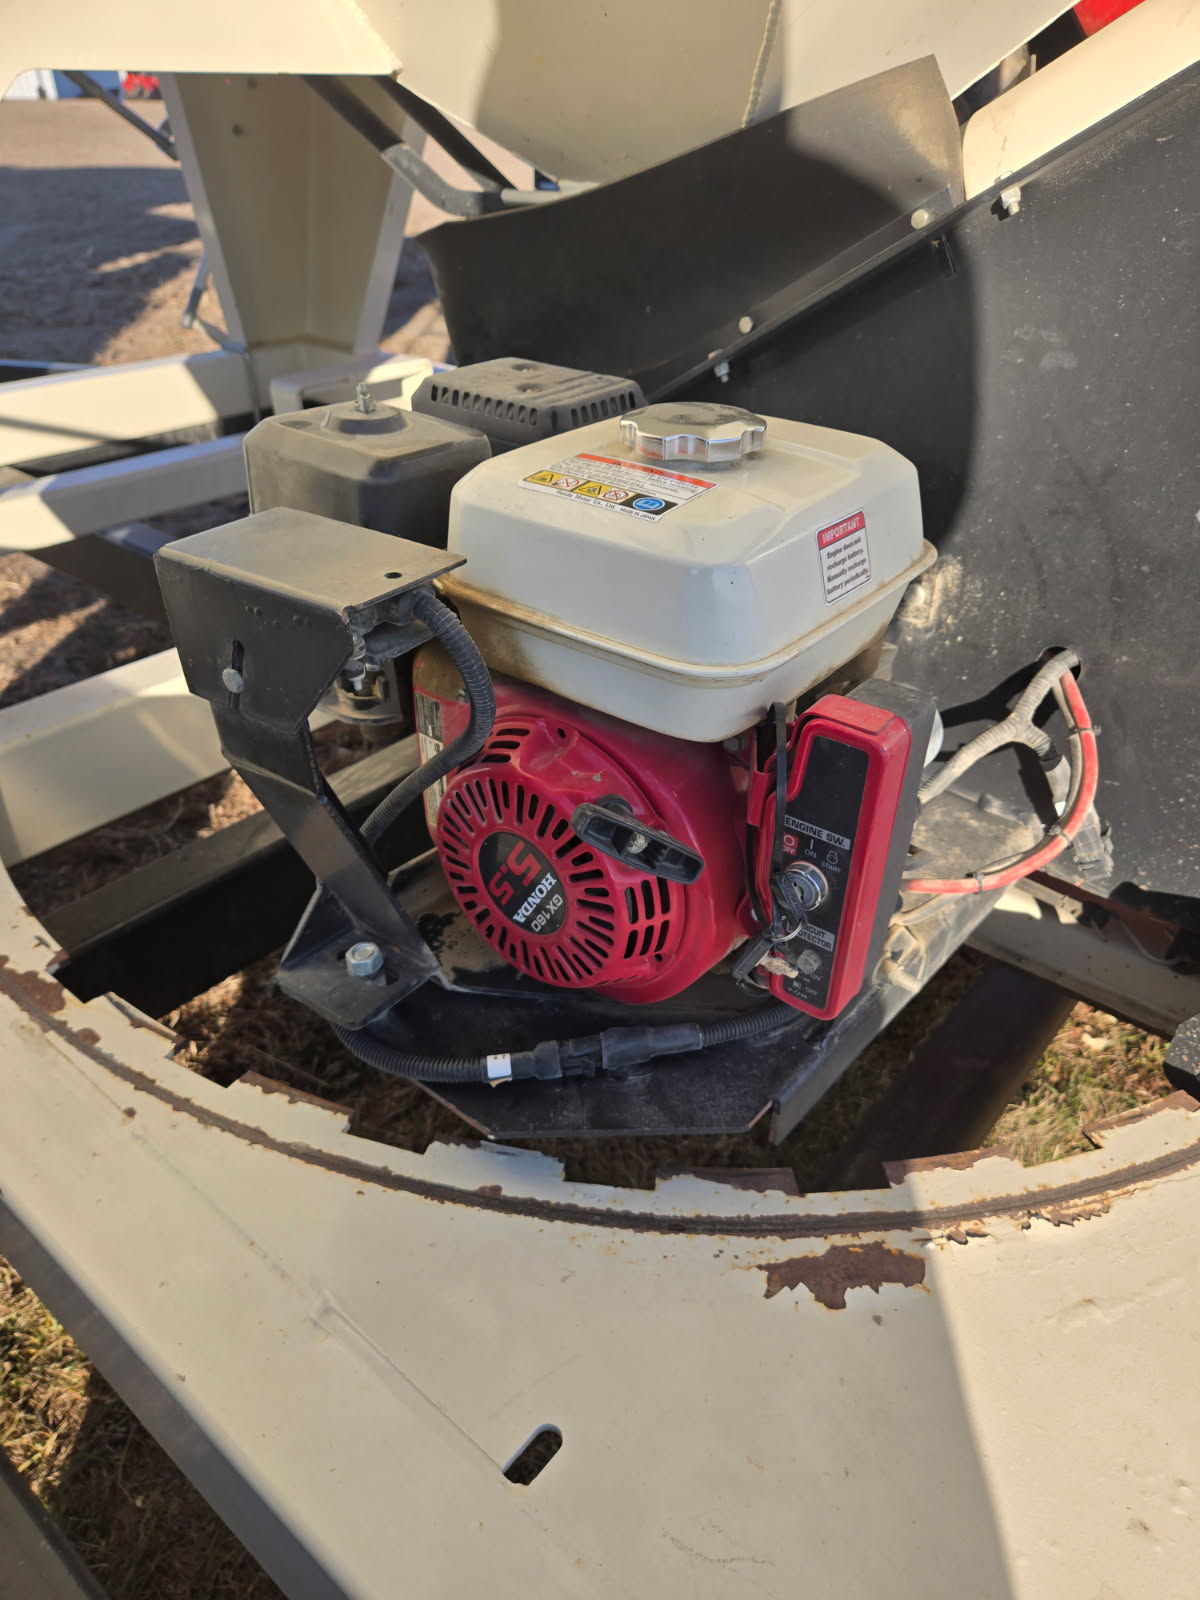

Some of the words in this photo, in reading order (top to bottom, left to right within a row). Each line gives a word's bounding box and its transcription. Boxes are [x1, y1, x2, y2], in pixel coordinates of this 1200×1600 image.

[822, 517, 860, 543] IMPORTANT
[827, 548, 843, 559] Engine
[843, 542, 853, 551] does
[827, 557, 847, 570] recharge
[827, 568, 847, 582] Manually
[848, 558, 866, 572] recharge
[827, 582, 843, 595] battery
[785, 816, 823, 838] ENGINE
[826, 832, 846, 848] SW.
[804, 849, 817, 859] ON
[489, 841, 542, 905] 5.5
[821, 861, 841, 873] START
[512, 872, 557, 923] HONDA
[797, 930, 832, 949] OTECTOR
